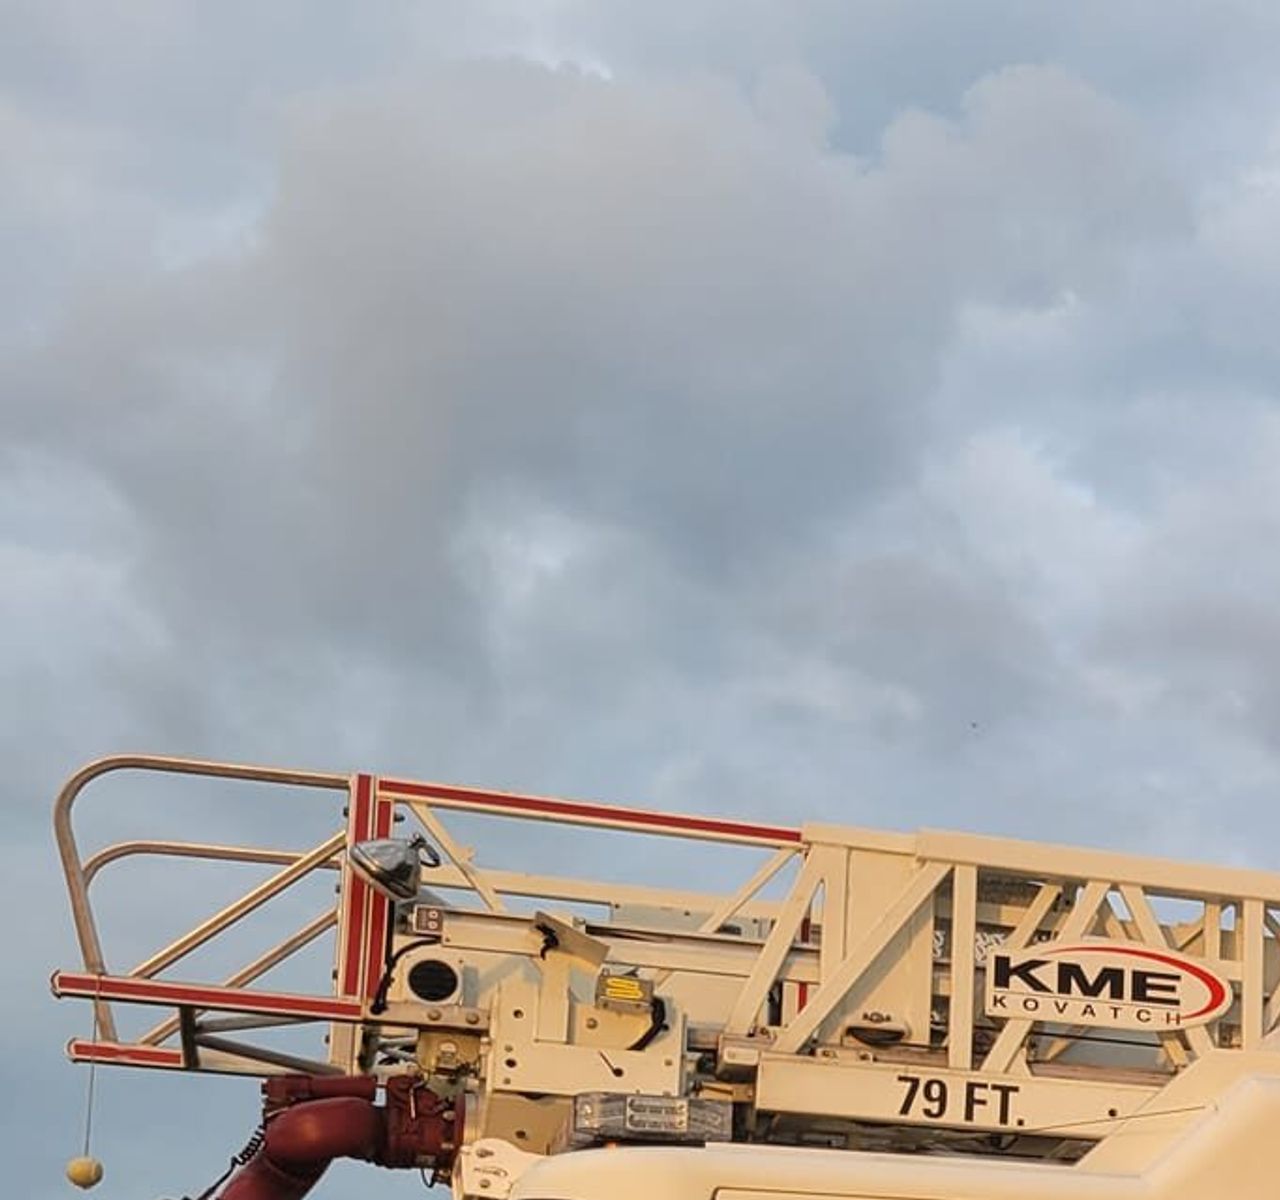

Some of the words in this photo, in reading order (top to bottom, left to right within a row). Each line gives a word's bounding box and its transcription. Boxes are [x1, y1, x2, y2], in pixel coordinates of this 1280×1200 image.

[994, 955, 1181, 1006] KME
[993, 995, 1181, 1026] KOVATCH
[897, 1075, 948, 1119] 79
[964, 1081, 1025, 1126] FT.
